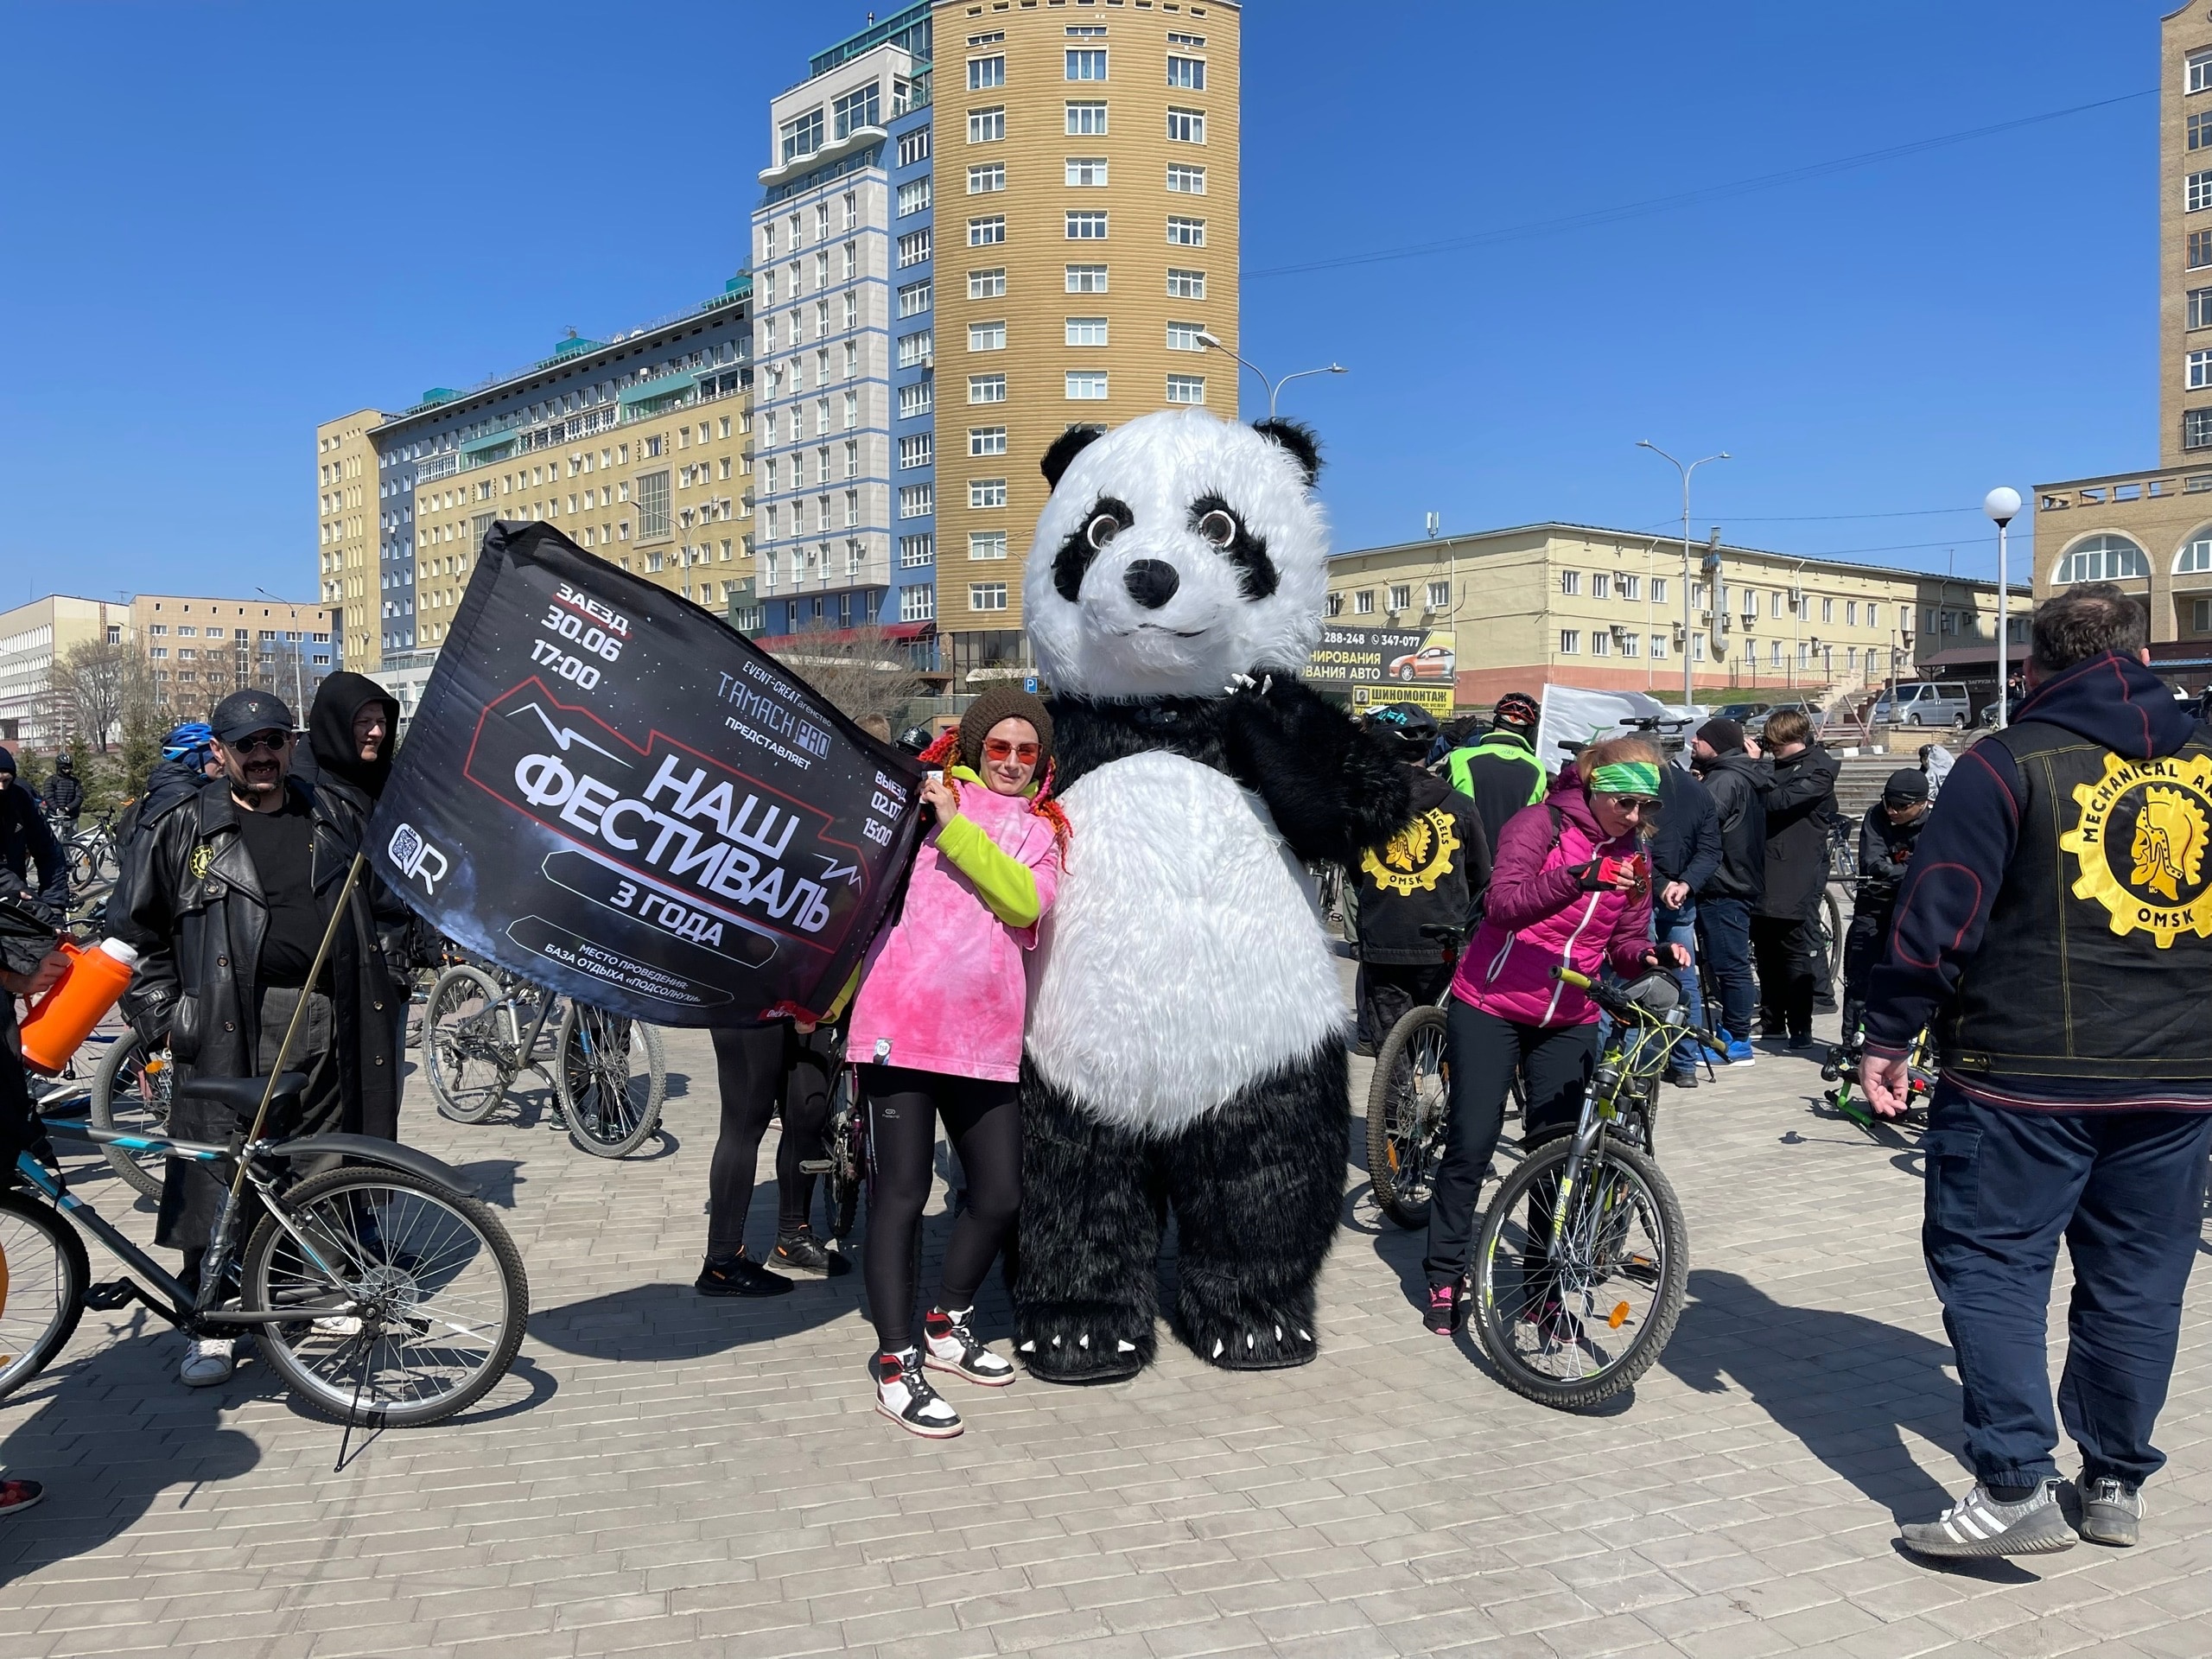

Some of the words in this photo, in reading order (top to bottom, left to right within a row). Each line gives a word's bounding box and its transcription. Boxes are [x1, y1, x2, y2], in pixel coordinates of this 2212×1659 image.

[556, 582, 629, 637] ЗАЕЗД
[541, 604, 623, 662] 30.06
[1324, 632, 1365, 645] 288-248
[1381, 634, 1421, 647] 347-077
[531, 639, 601, 690] 17:00
[1308, 650, 1382, 664] НИРОВАНИЯ
[1350, 667, 1381, 680] АВТО
[742, 660, 801, 703] EVENT-CREAT
[1027, 678, 1034, 691] P
[1371, 689, 1447, 702] ШИНОМОНТАЖ
[724, 716, 811, 770] ПРЕДСТАВЛЯЕТ
[874, 770, 907, 803] ВЫЕЗД
[2082, 762, 2178, 843] MECHANICAL
[642, 753, 800, 861] НАШ
[871, 791, 905, 822] 02.07
[514, 753, 830, 933] ФЕСТИВАЛЬ
[862, 817, 893, 848] 15:00
[1430, 810, 1450, 845] NGELS
[1389, 874, 1423, 886] OMSK
[609, 880, 638, 908] 3
[638, 893, 724, 948] ГОДА
[2137, 907, 2196, 928] OMSK
[544, 943, 575, 963] БАЗА
[576, 957, 624, 982] ОТДЫХА
[579, 944, 619, 965] МЕСТО
[618, 960, 690, 990] ПРОВЕДЕНИЯ:
